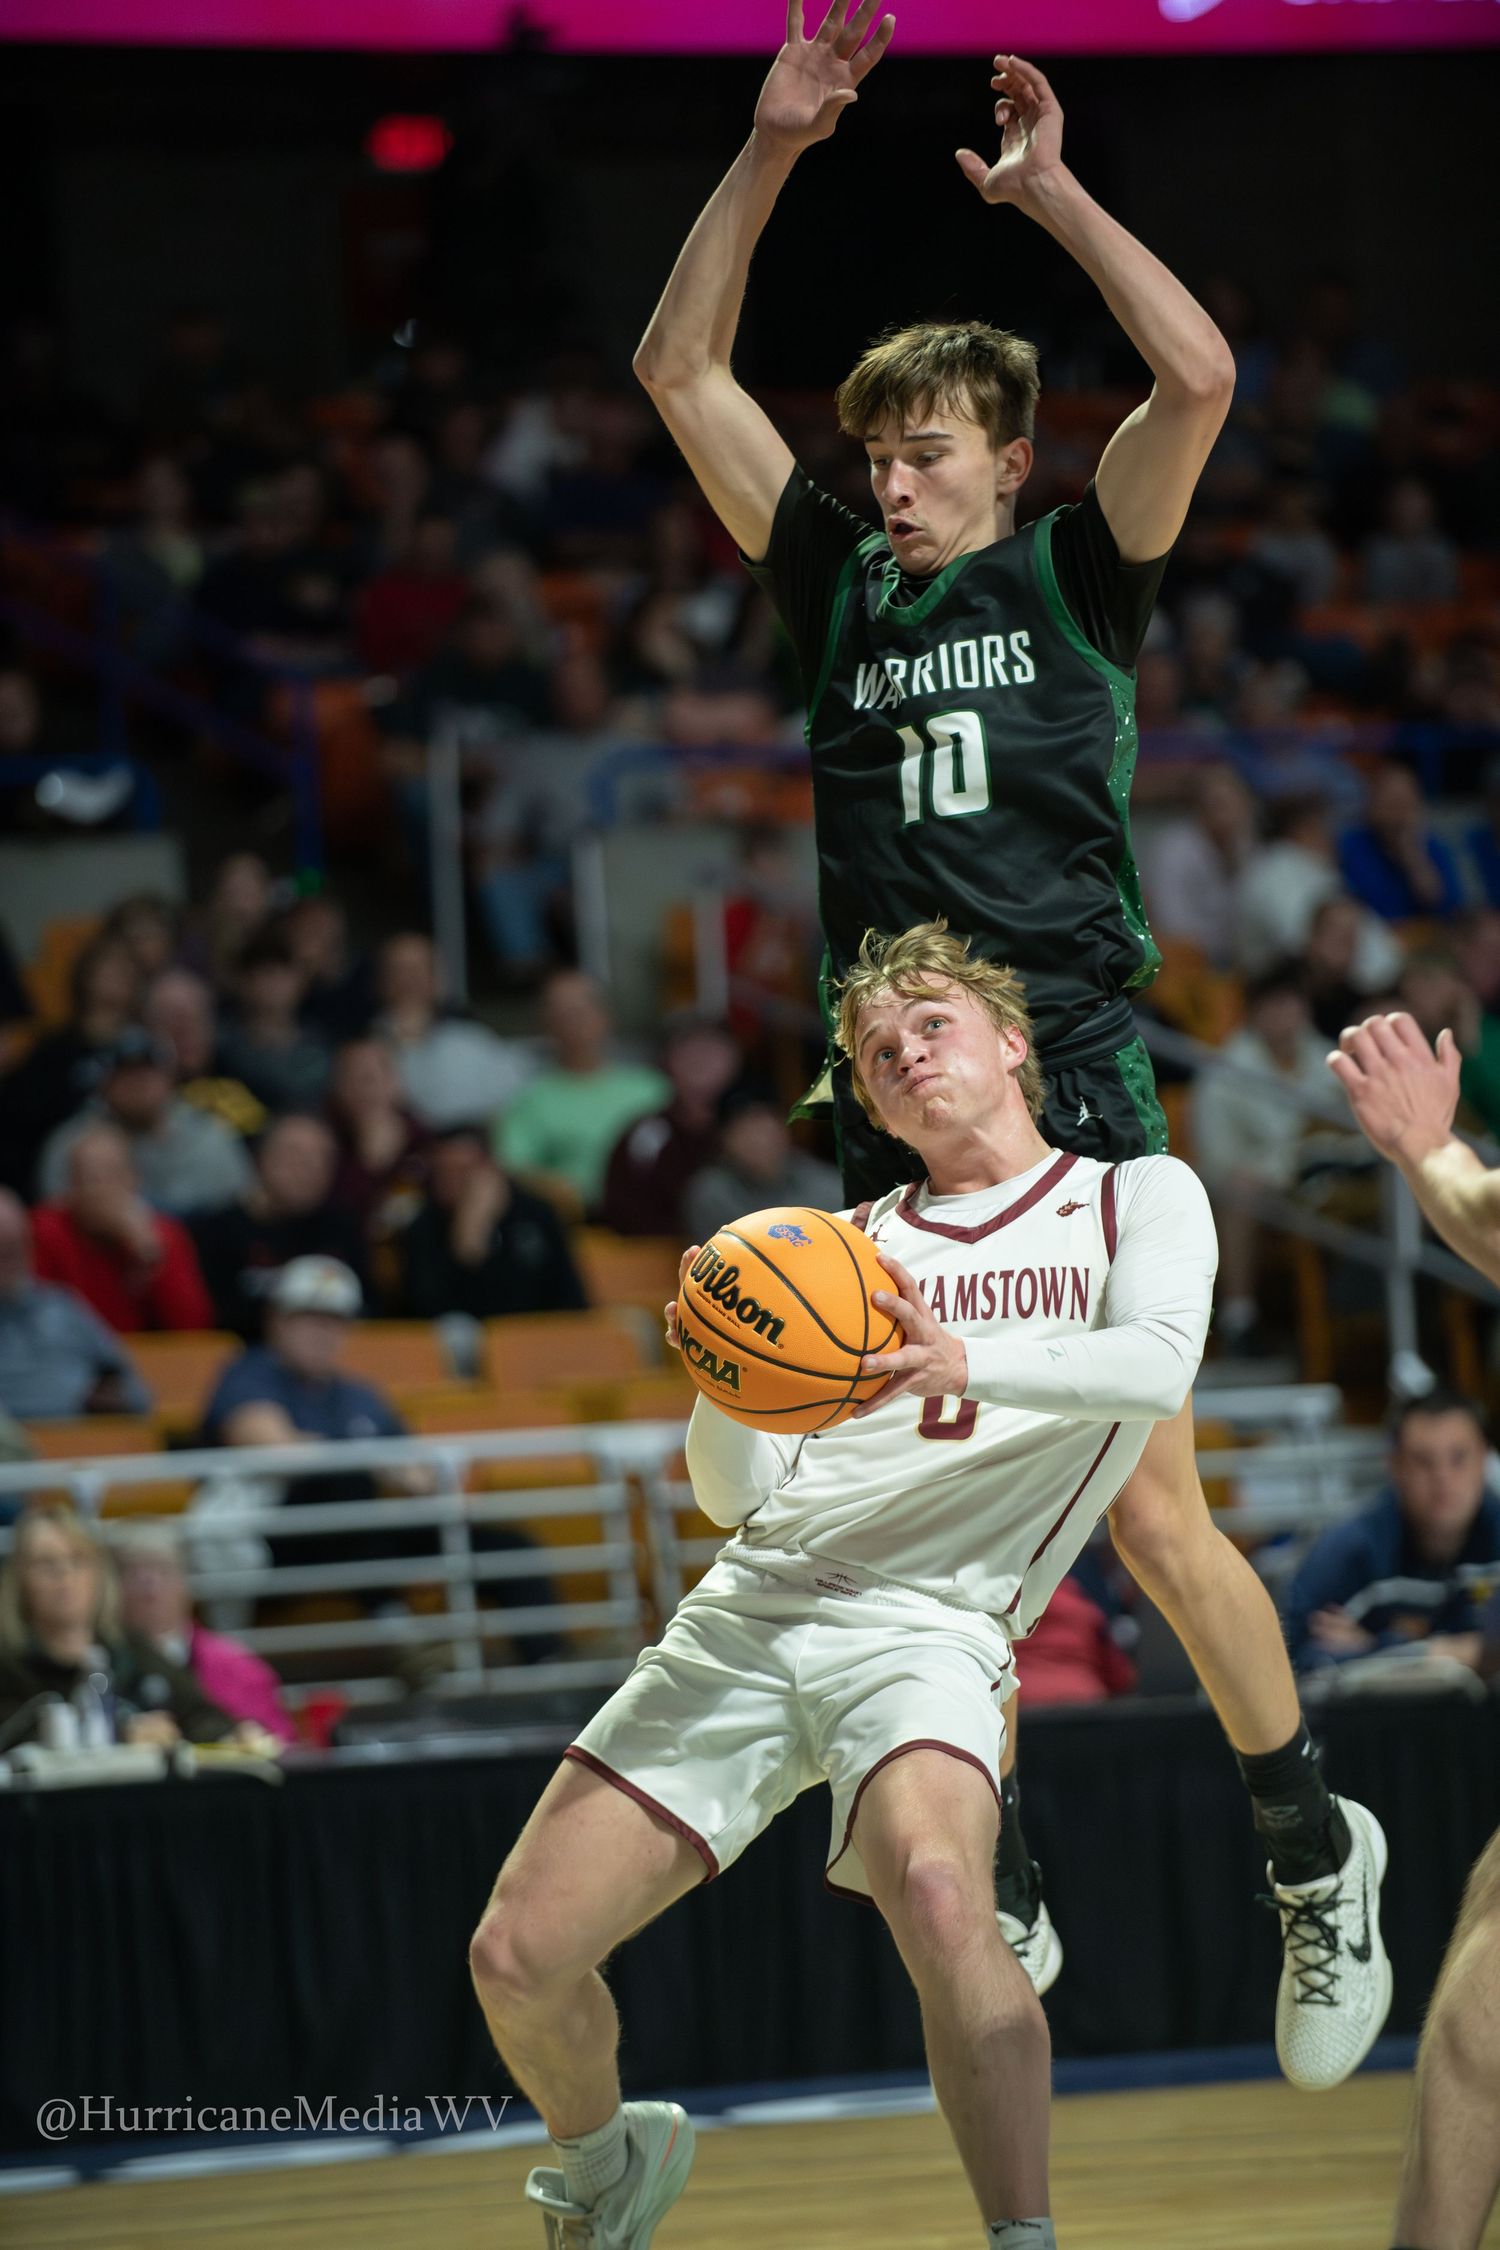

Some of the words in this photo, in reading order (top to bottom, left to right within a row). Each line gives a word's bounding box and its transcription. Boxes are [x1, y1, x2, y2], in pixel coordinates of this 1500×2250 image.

[853, 630, 1036, 711] WARRIORS
[896, 708, 991, 828] 10
[689, 1243, 785, 1346] Wilson
